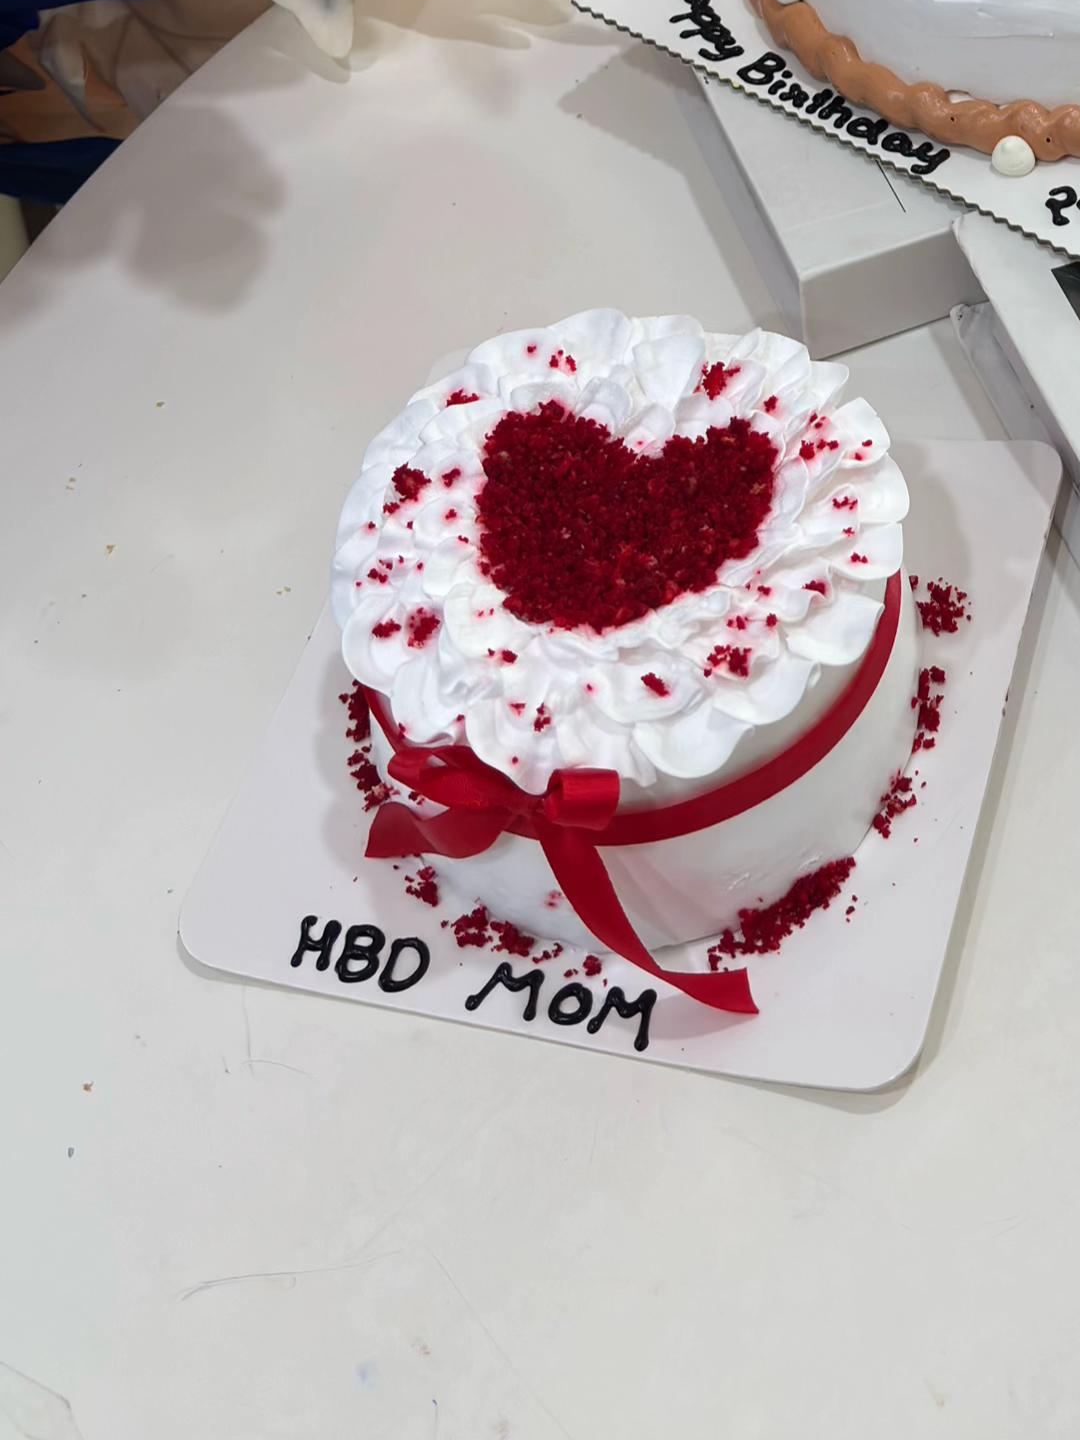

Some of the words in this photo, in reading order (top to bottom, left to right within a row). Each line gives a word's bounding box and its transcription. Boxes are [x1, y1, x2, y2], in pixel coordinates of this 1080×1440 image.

[736, 51, 951, 175] Birthday
[290, 915, 431, 993] HBD
[465, 962, 658, 1052] MOM
